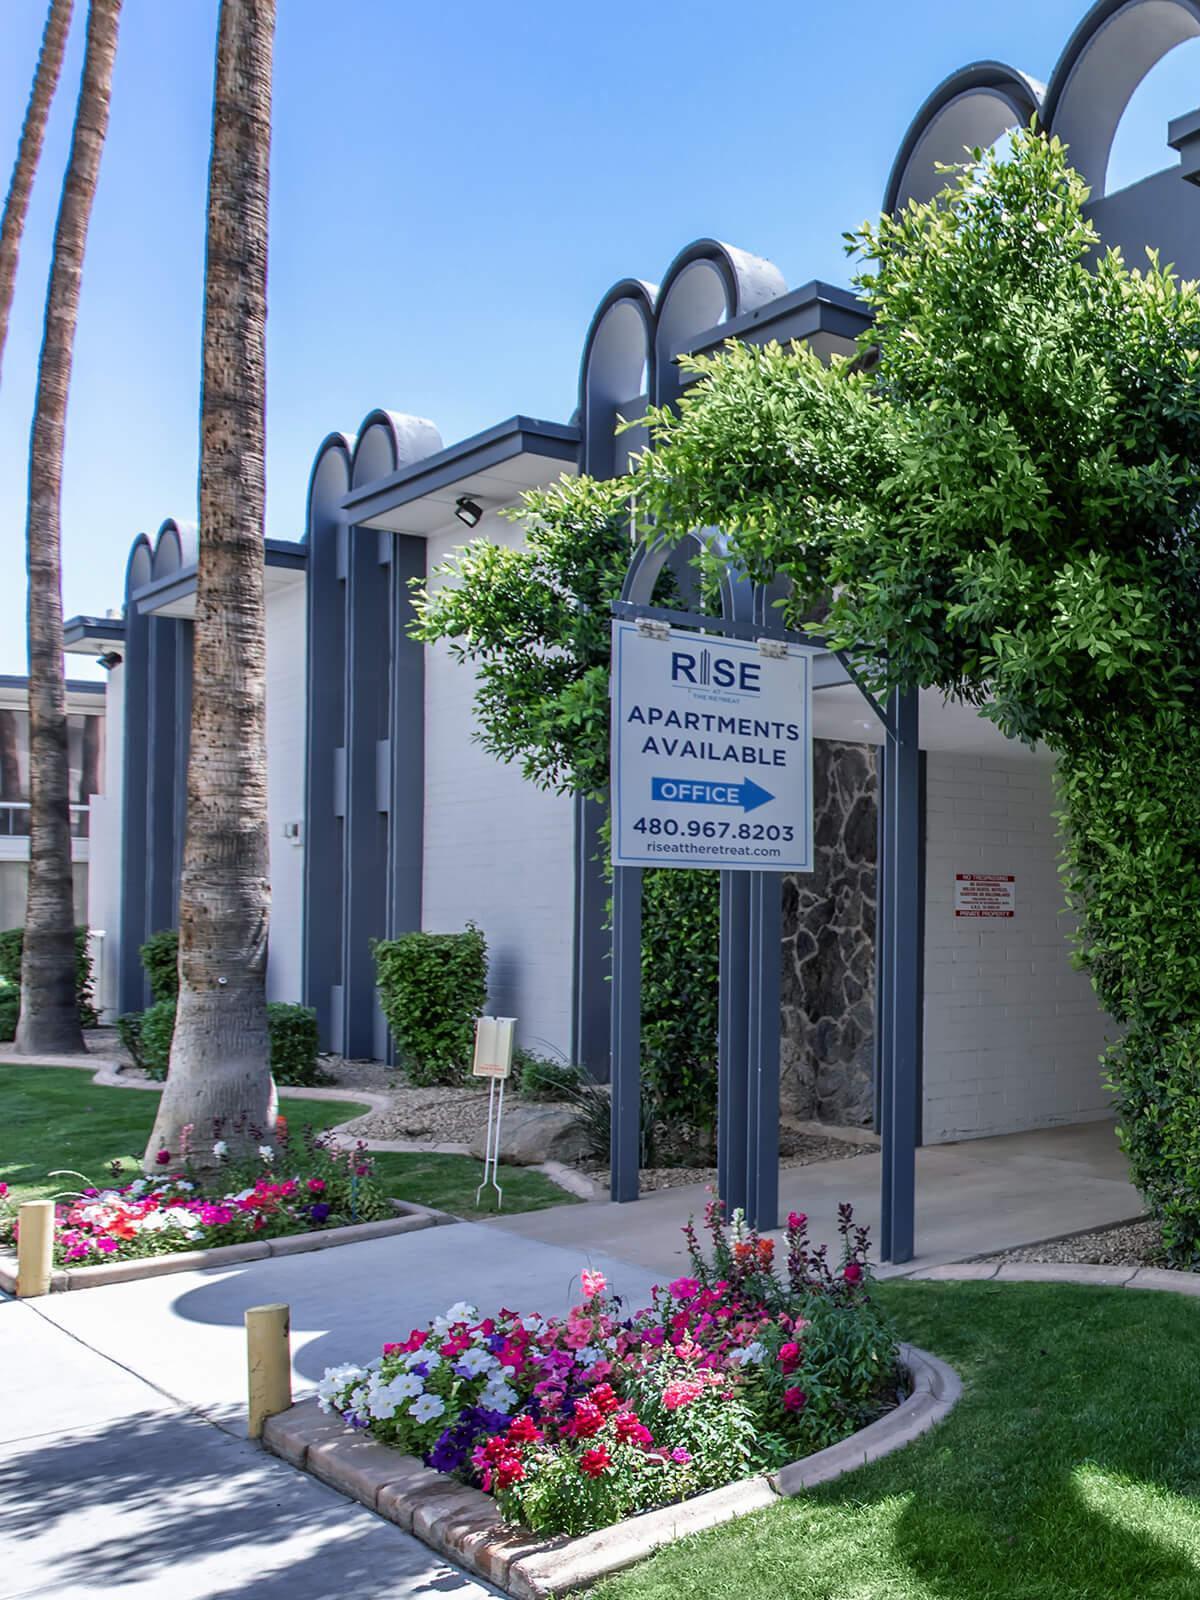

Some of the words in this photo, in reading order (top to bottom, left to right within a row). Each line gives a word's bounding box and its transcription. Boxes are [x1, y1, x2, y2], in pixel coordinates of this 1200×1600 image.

[672, 648, 760, 692] RISE
[627, 705, 799, 741] APARTMENTS
[642, 736, 786, 766] AVAILABLE
[661, 783, 739, 803] OFFICE
[633, 817, 794, 841] 480.967.8203
[647, 840, 781, 857] riseattheretreat.com
